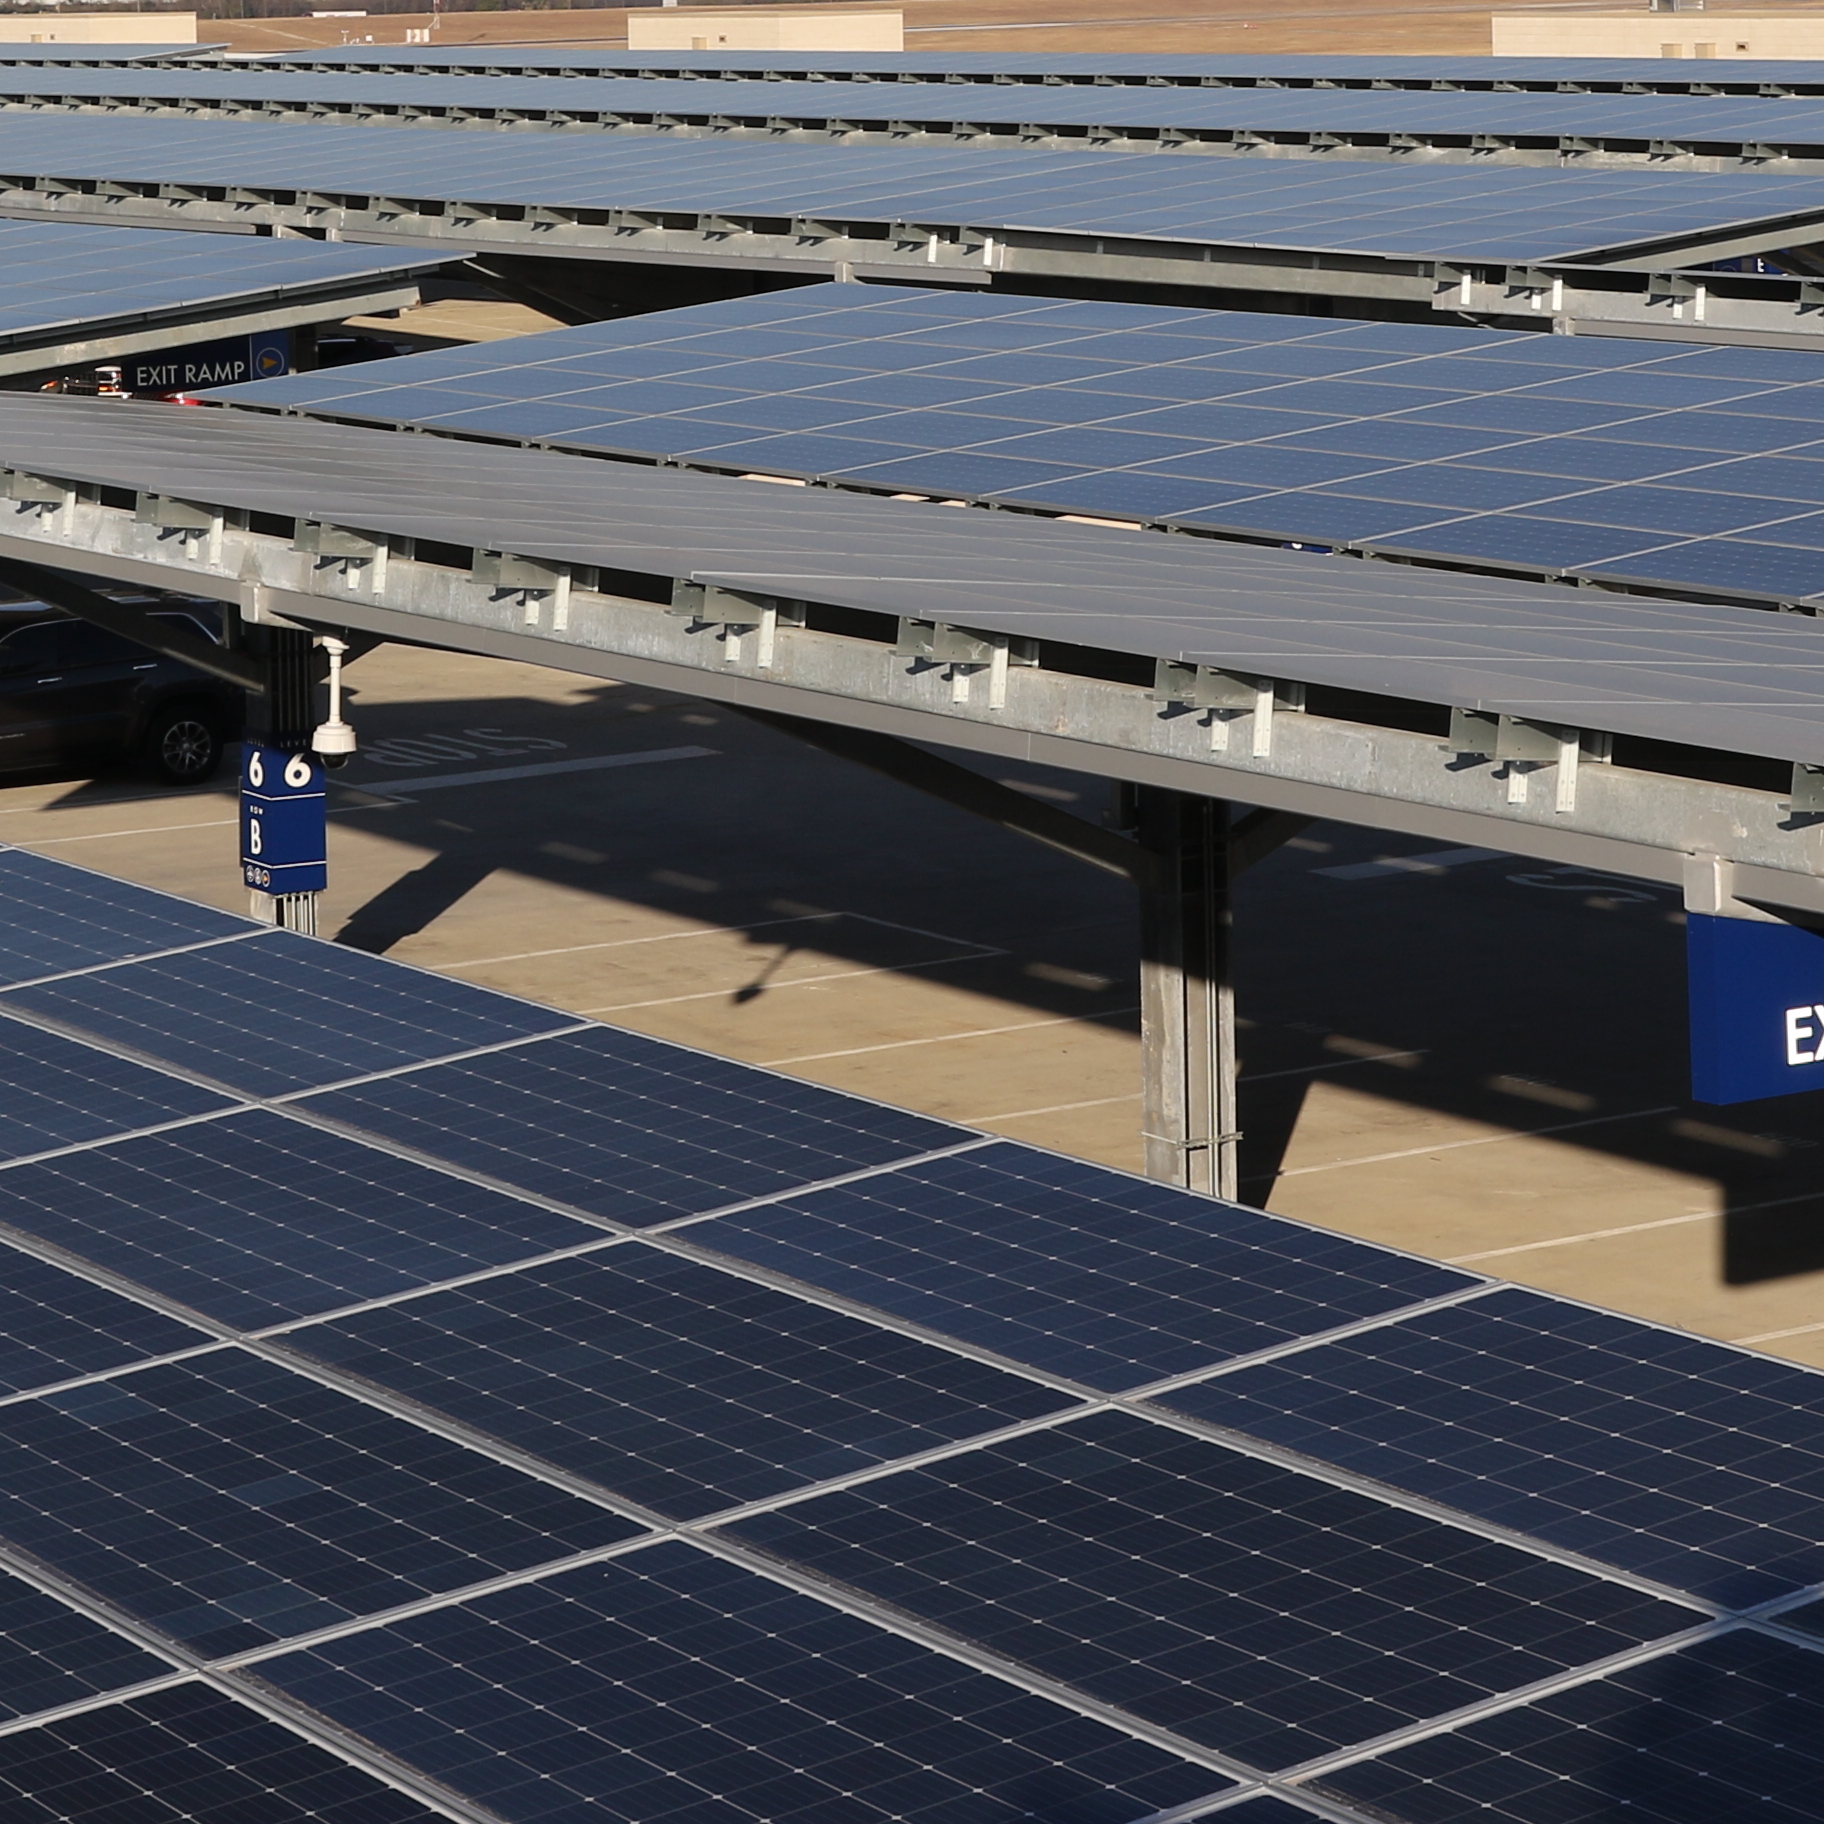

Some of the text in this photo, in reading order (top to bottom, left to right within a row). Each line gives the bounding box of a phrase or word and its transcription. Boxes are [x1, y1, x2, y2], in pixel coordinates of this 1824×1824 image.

[136, 361, 245, 387] EXIT RAMP
[280, 738, 307, 748] LEVE
[249, 751, 264, 788] 6
[284, 753, 312, 788] 6
[250, 818, 262, 855] B
